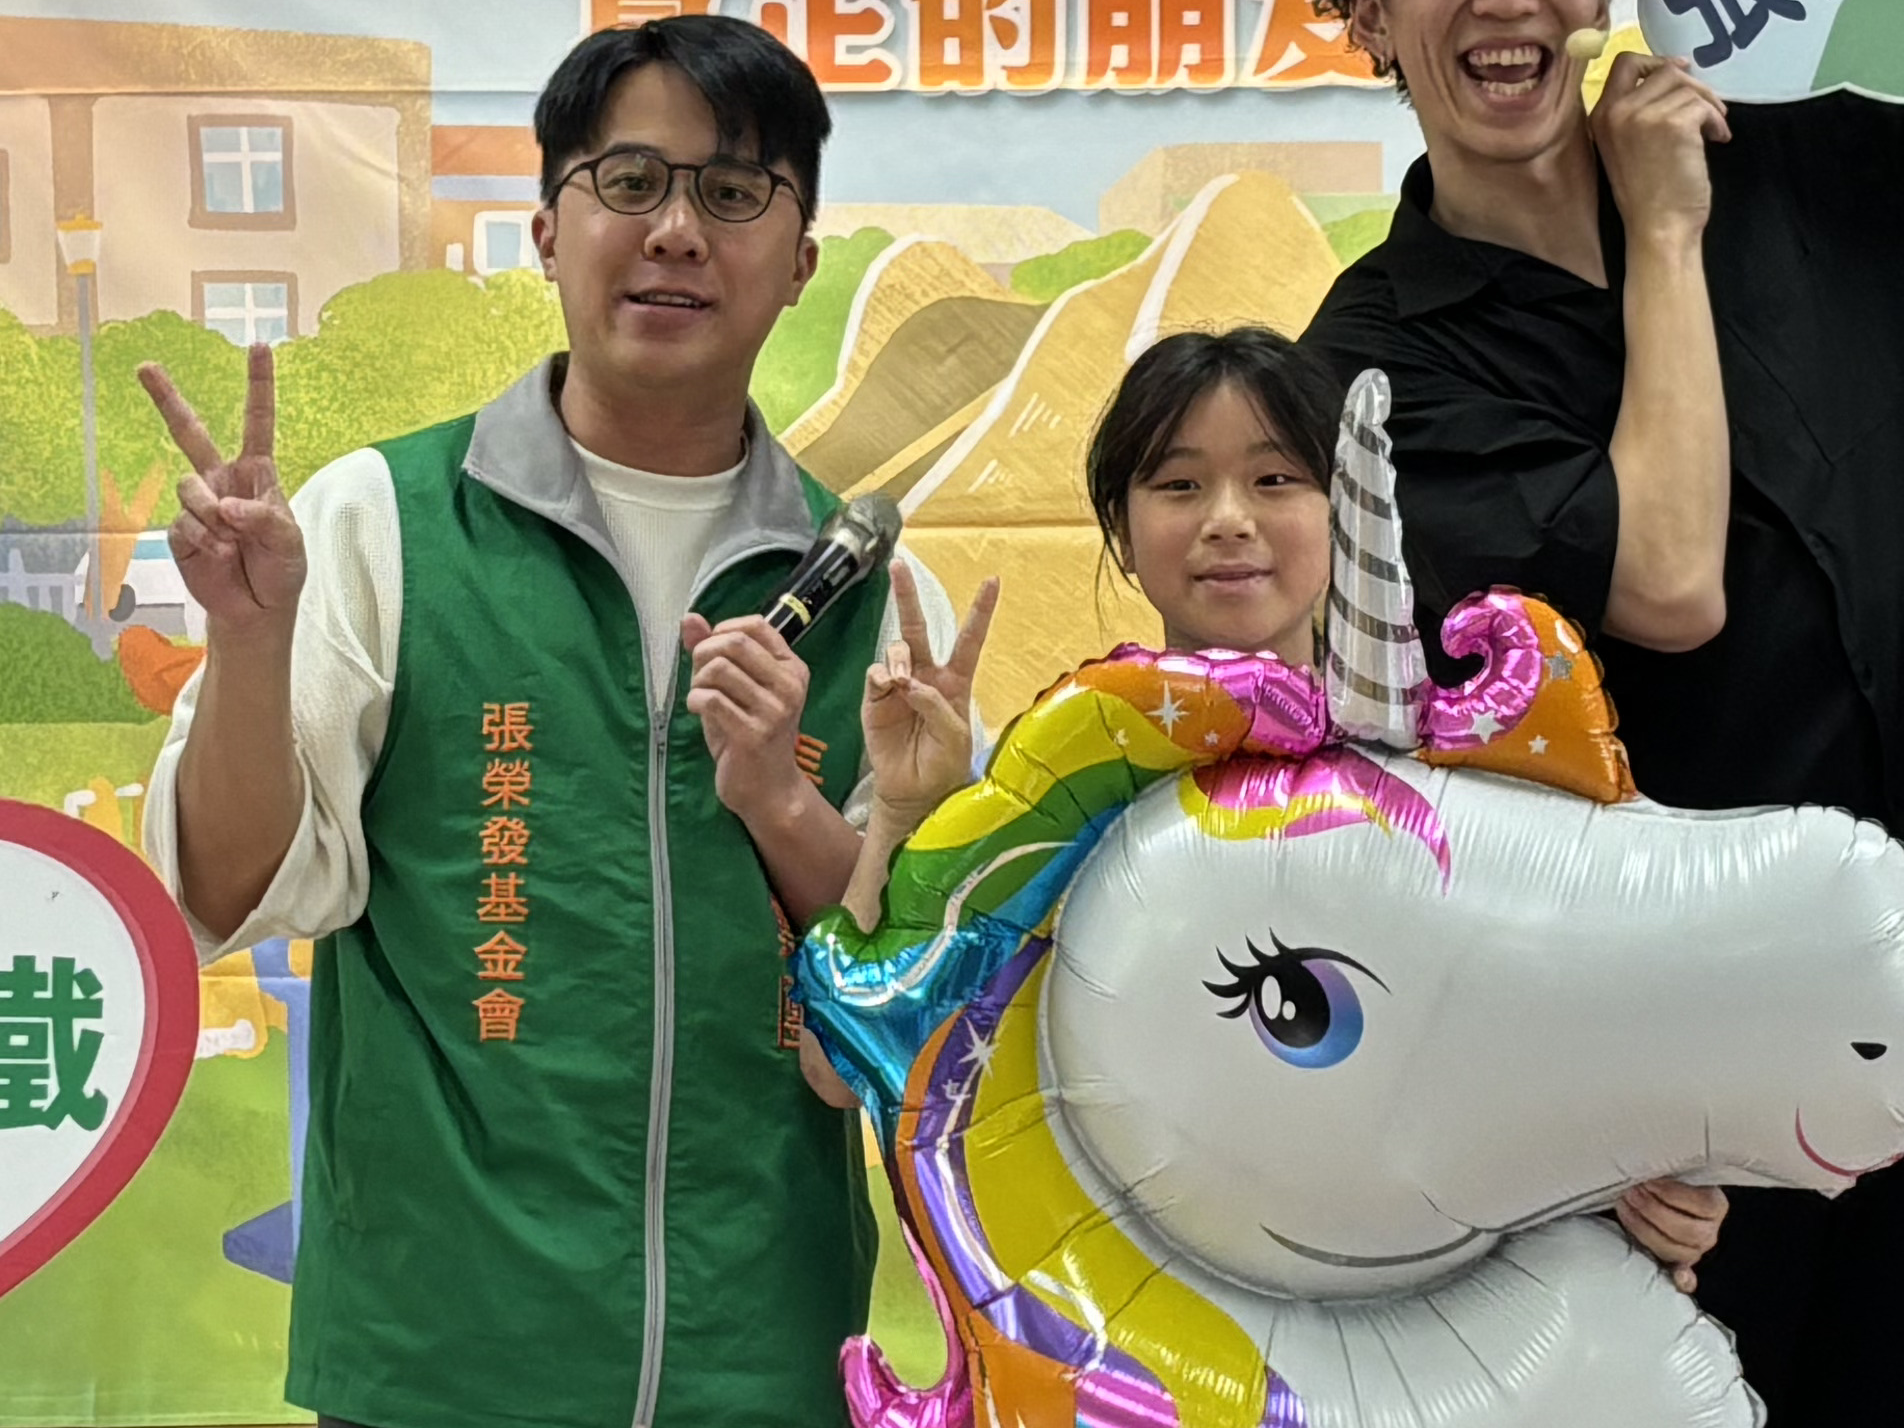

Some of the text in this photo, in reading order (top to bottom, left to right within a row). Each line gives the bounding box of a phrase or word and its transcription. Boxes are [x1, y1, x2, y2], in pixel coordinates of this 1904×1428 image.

[471, 701, 534, 1043] 張榮發基金會
